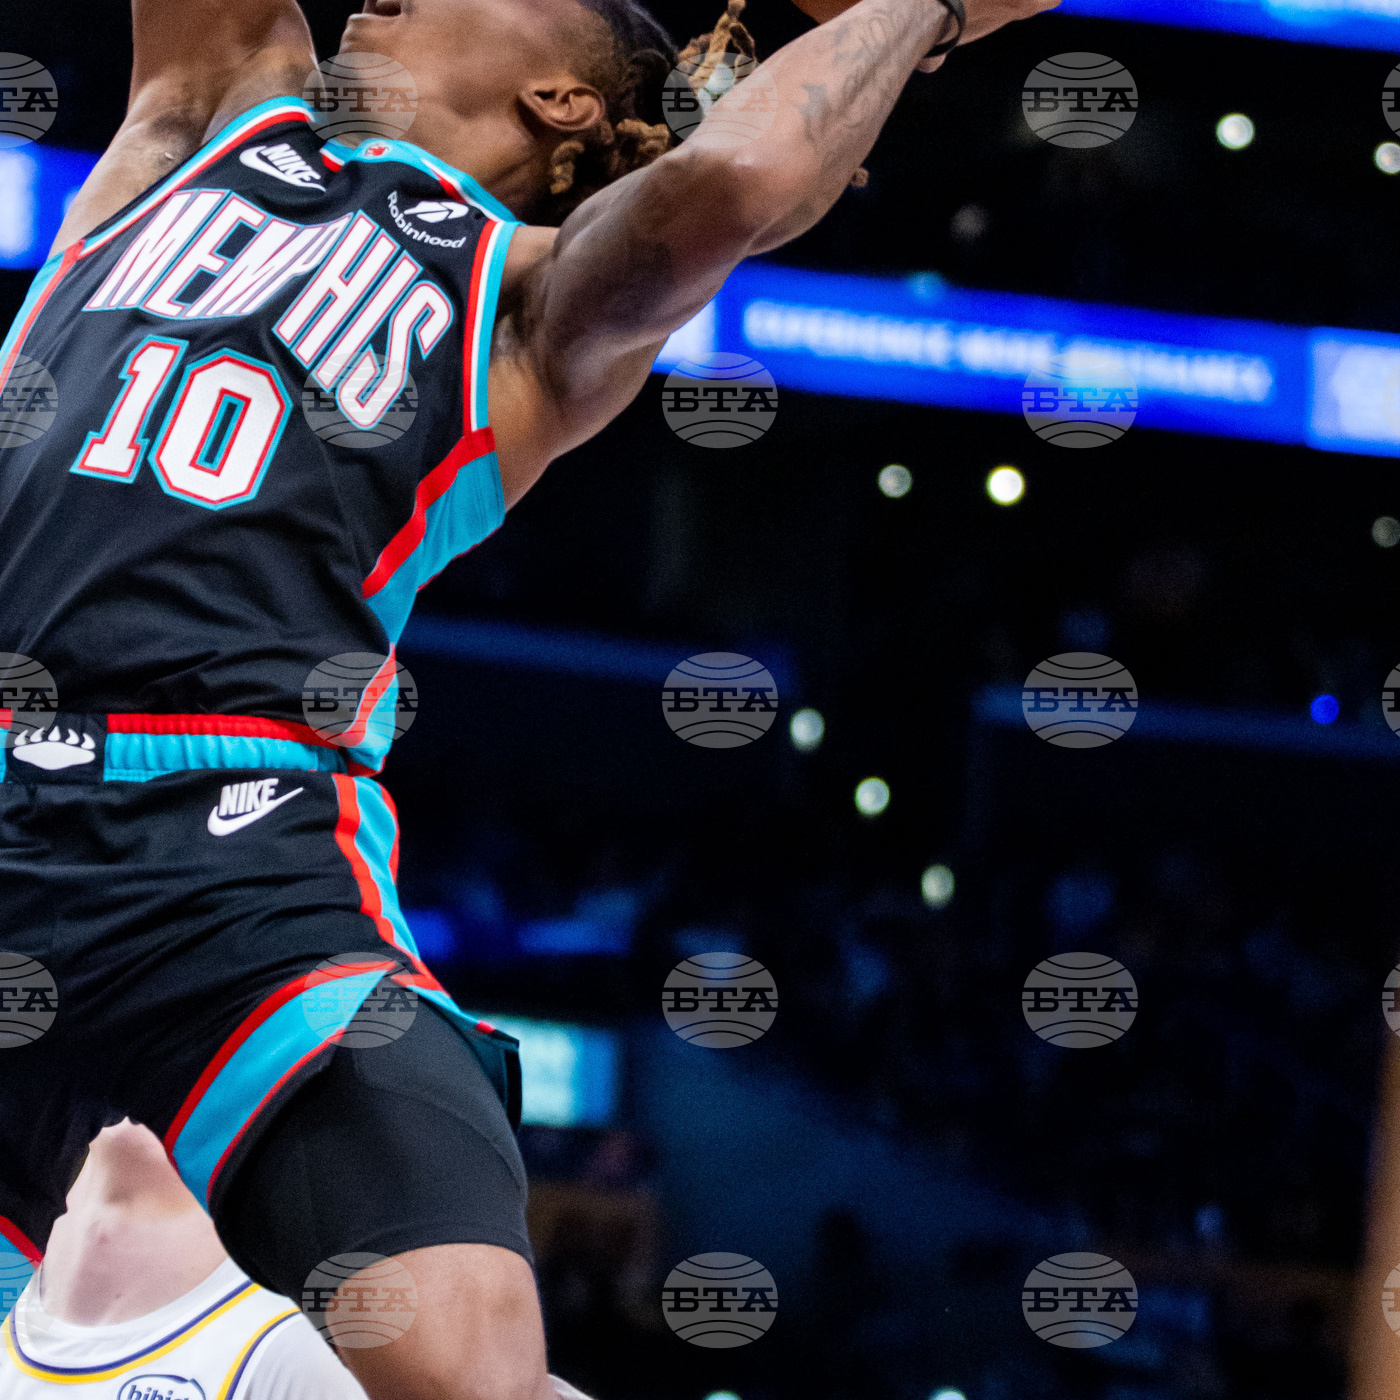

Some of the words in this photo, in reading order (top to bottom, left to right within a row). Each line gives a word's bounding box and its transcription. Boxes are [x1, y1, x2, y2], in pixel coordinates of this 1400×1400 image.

[259, 142, 322, 183] NIKE
[387, 190, 467, 248] Robinhood
[81, 188, 455, 431] MEMPHIS
[68, 333, 293, 511] 10
[218, 777, 279, 817] NIKE
